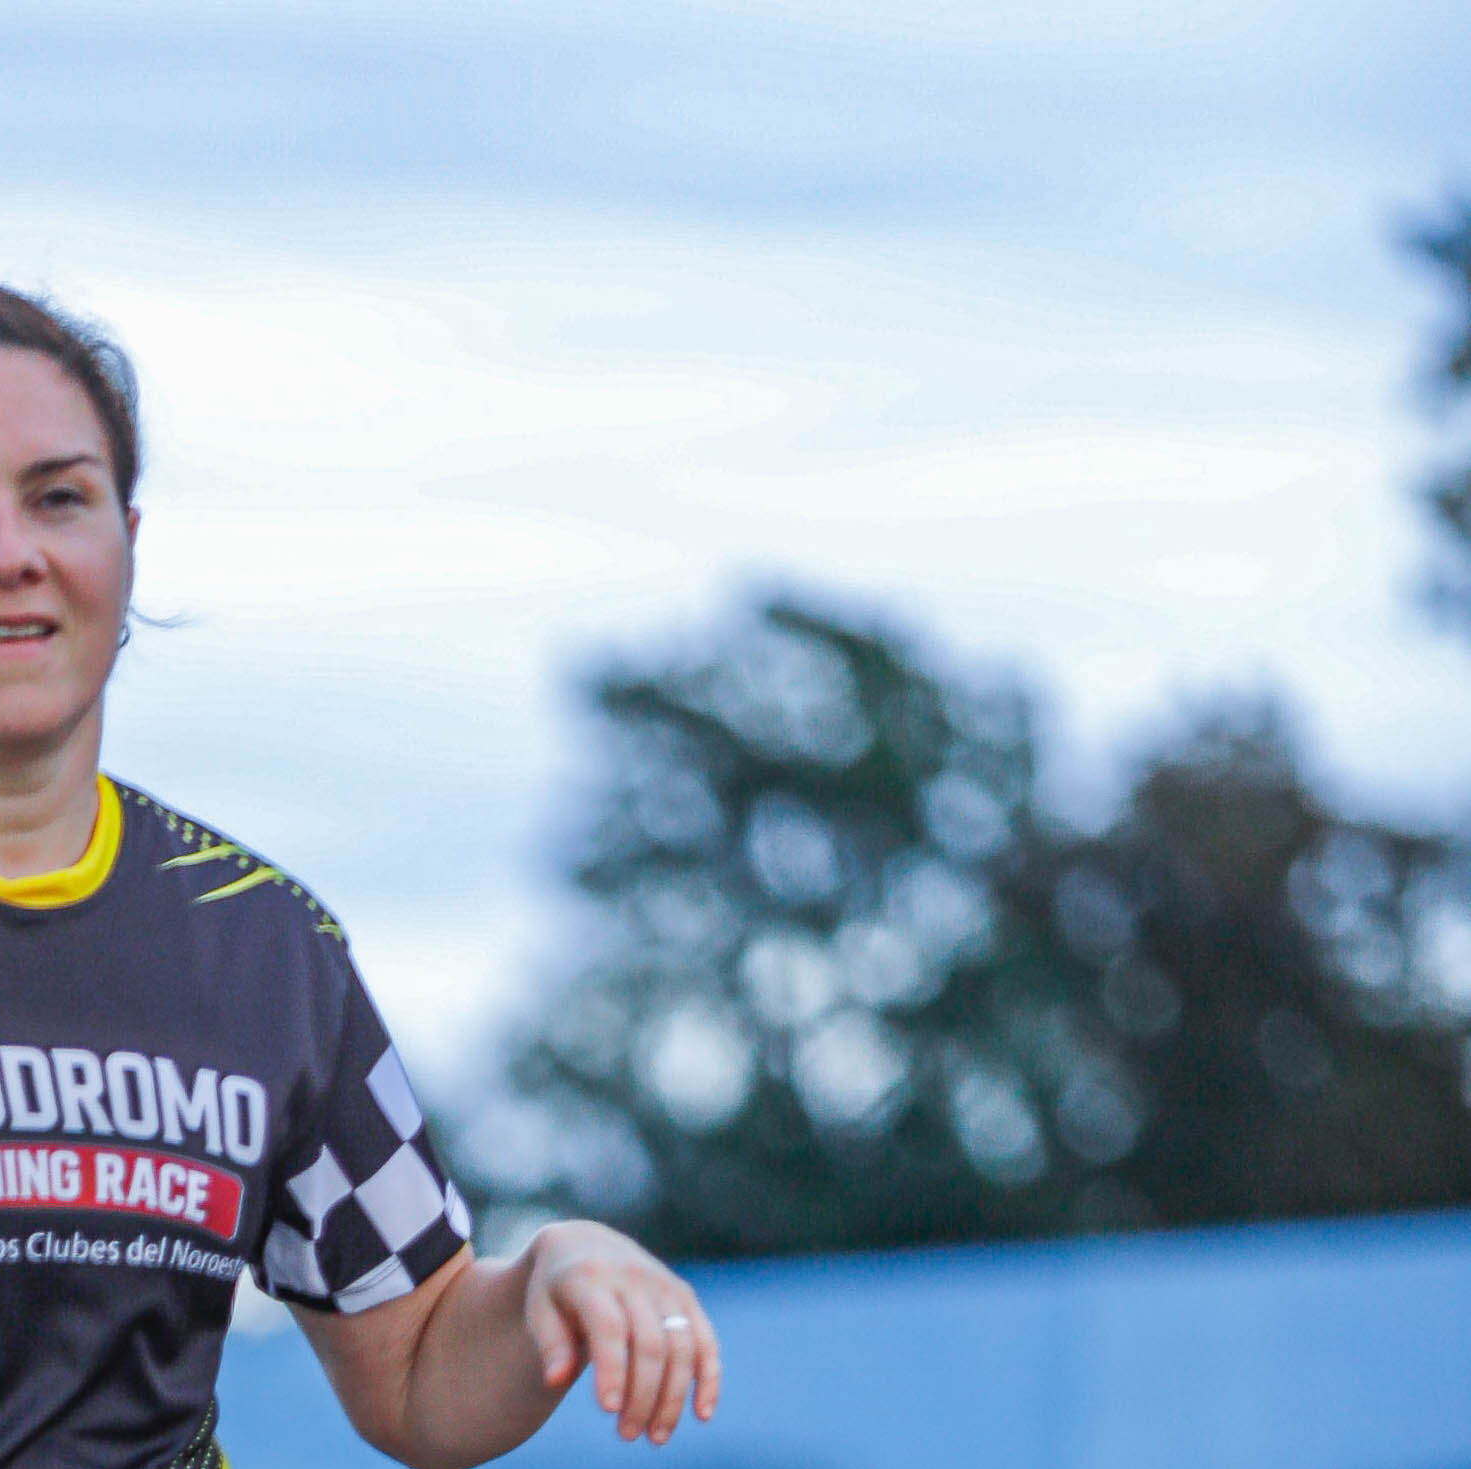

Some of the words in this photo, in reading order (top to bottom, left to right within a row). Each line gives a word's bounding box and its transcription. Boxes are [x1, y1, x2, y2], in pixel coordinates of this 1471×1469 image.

[95, 1151, 210, 1222] RACE
[27, 1231, 120, 1266] Clubes
[127, 1234, 167, 1268] del
